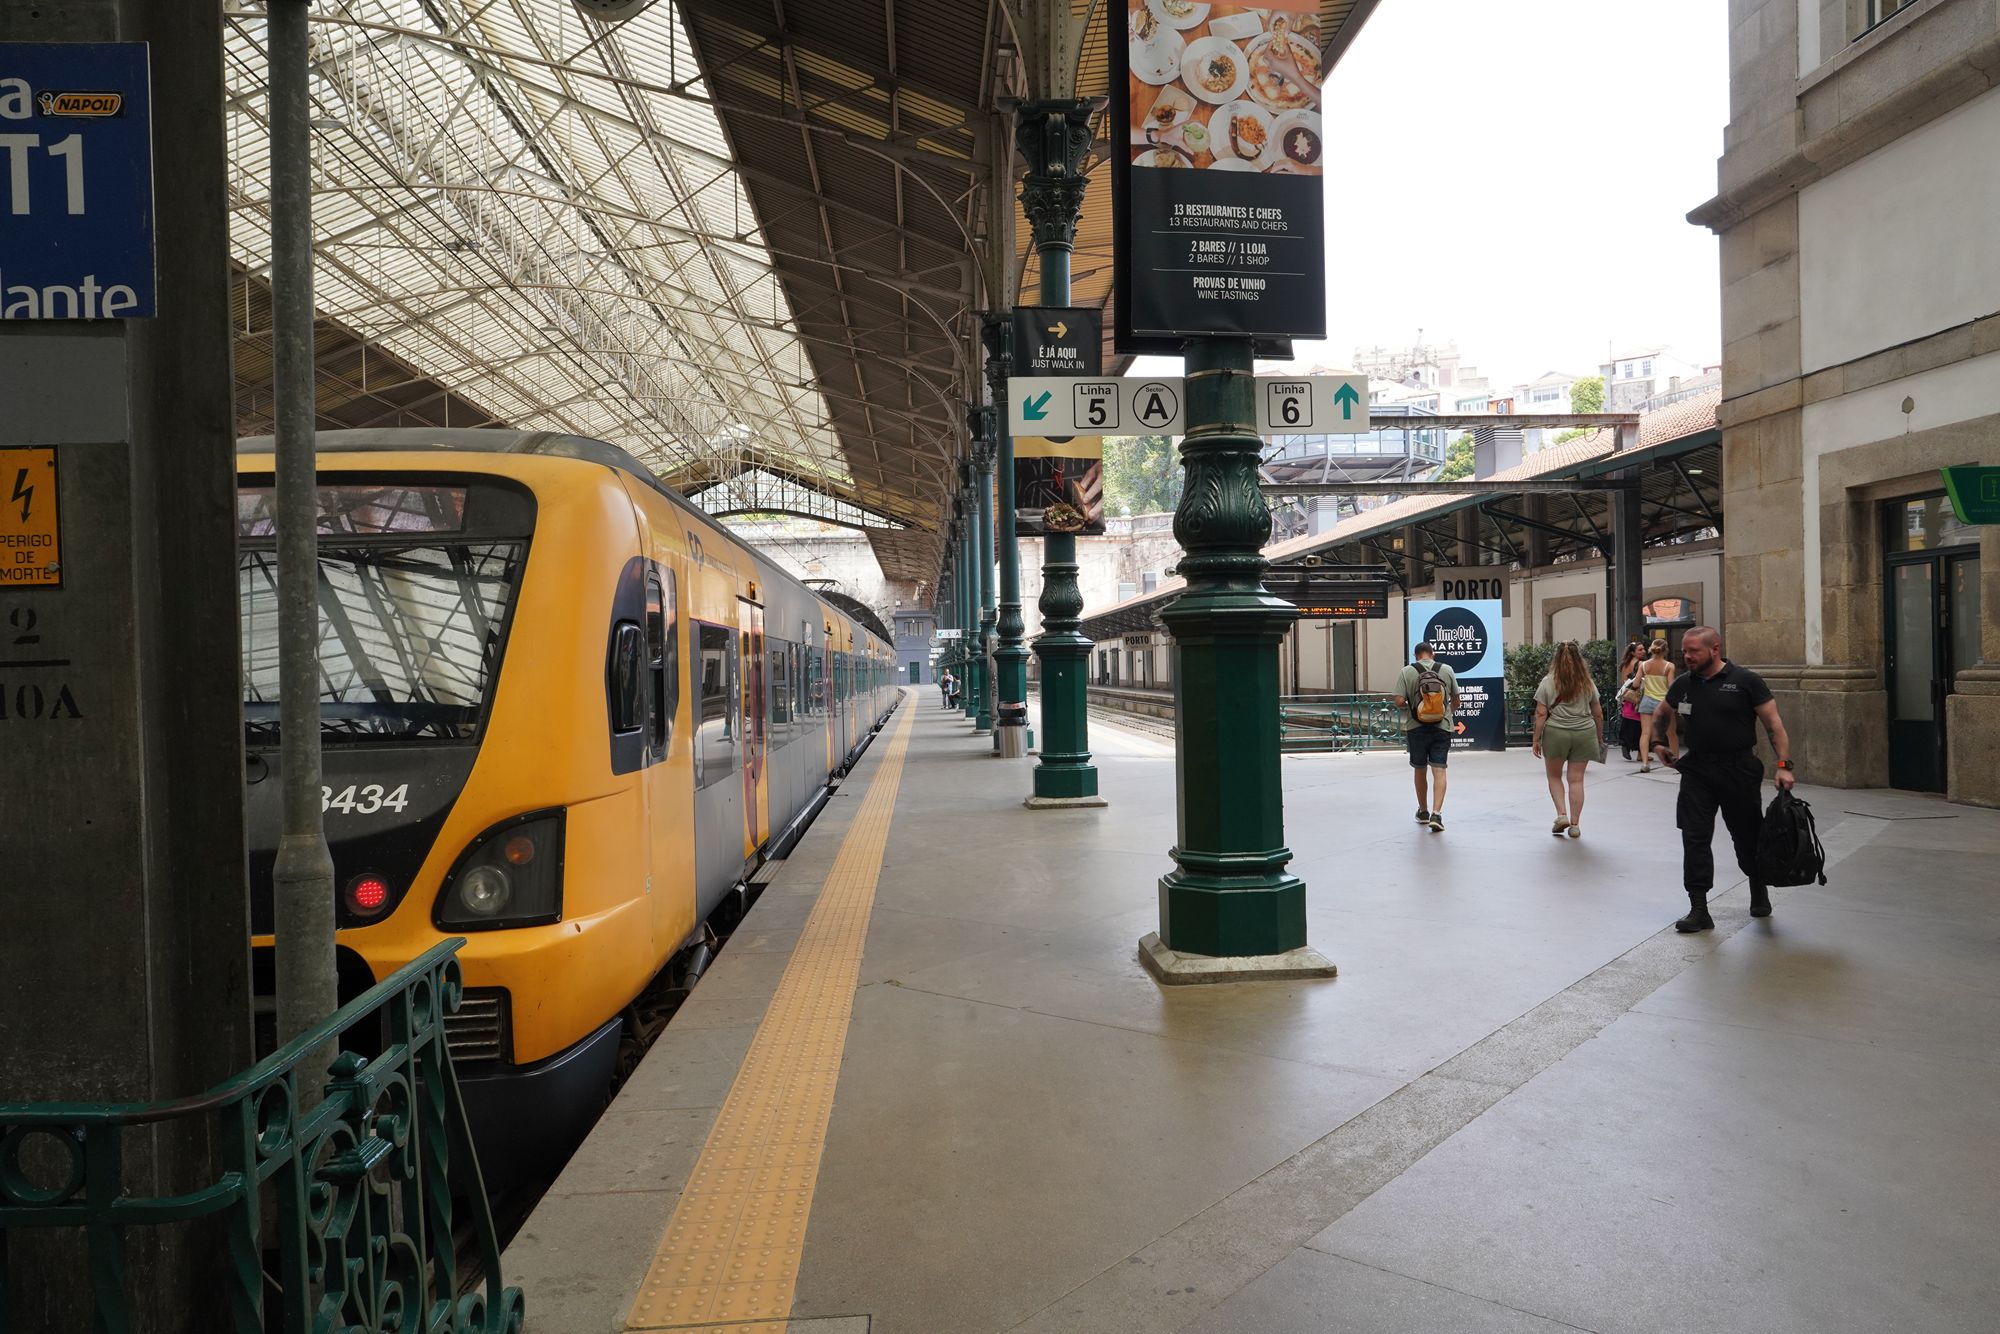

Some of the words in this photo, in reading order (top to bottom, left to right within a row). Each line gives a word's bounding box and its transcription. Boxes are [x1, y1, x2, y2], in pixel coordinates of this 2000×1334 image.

[58, 99, 115, 111] NAPOLI
[1174, 204, 1184, 215] 13
[1186, 204, 1247, 219] RESTAURANTES
[1249, 207, 1254, 218] E
[1256, 208, 1282, 220] CHEFS
[1170, 217, 1180, 226] 13
[1183, 217, 1240, 229] RESTAURANTS
[1241, 220, 1259, 229] AND
[1261, 220, 1288, 231] CHEFS
[1191, 241, 1197, 252] 2
[1199, 241, 1226, 253] BARES
[1228, 241, 1237, 253] //
[1240, 243, 1245, 254] 1
[1247, 243, 1267, 254] LOJA
[1188, 253, 1194, 263] 2
[1197, 254, 1225, 263] BARES
[1226, 255, 1236, 265] //
[1240, 256, 1244, 264] 1
[1247, 256, 1270, 265] SHOP
[1193, 277, 1226, 289] PROVAS
[1228, 277, 1239, 289] DE
[1240, 278, 1266, 290] VINHO
[0, 274, 138, 319] ante
[1197, 290, 1219, 299] WINE
[1220, 290, 1259, 300] TASTINGS
[1039, 345, 1045, 359] É
[1046, 345, 1056, 359] JÁ
[1057, 347, 1077, 360] AQUI
[1031, 359, 1051, 369] JUST
[1051, 359, 1074, 369] WALK
[1076, 360, 1085, 369] IN
[1080, 385, 1112, 395] Linha
[1274, 385, 1305, 394] Linha
[1088, 398, 1107, 426] 5
[1142, 393, 1169, 420] A
[1282, 397, 1300, 424] 6
[0, 534, 52, 548] PERIGO
[15, 551, 35, 564] DE
[0, 567, 52, 580] MORTE
[1442, 578, 1502, 600] PORTO
[10, 607, 40, 645] 2
[1435, 624, 1458, 641] Time
[1458, 625, 1475, 641] Out
[1125, 635, 1150, 646] PORTO
[1430, 642, 1482, 651] MARKET
[1474, 701, 1485, 709] CITY
[1467, 709, 1480, 717] ROOF
